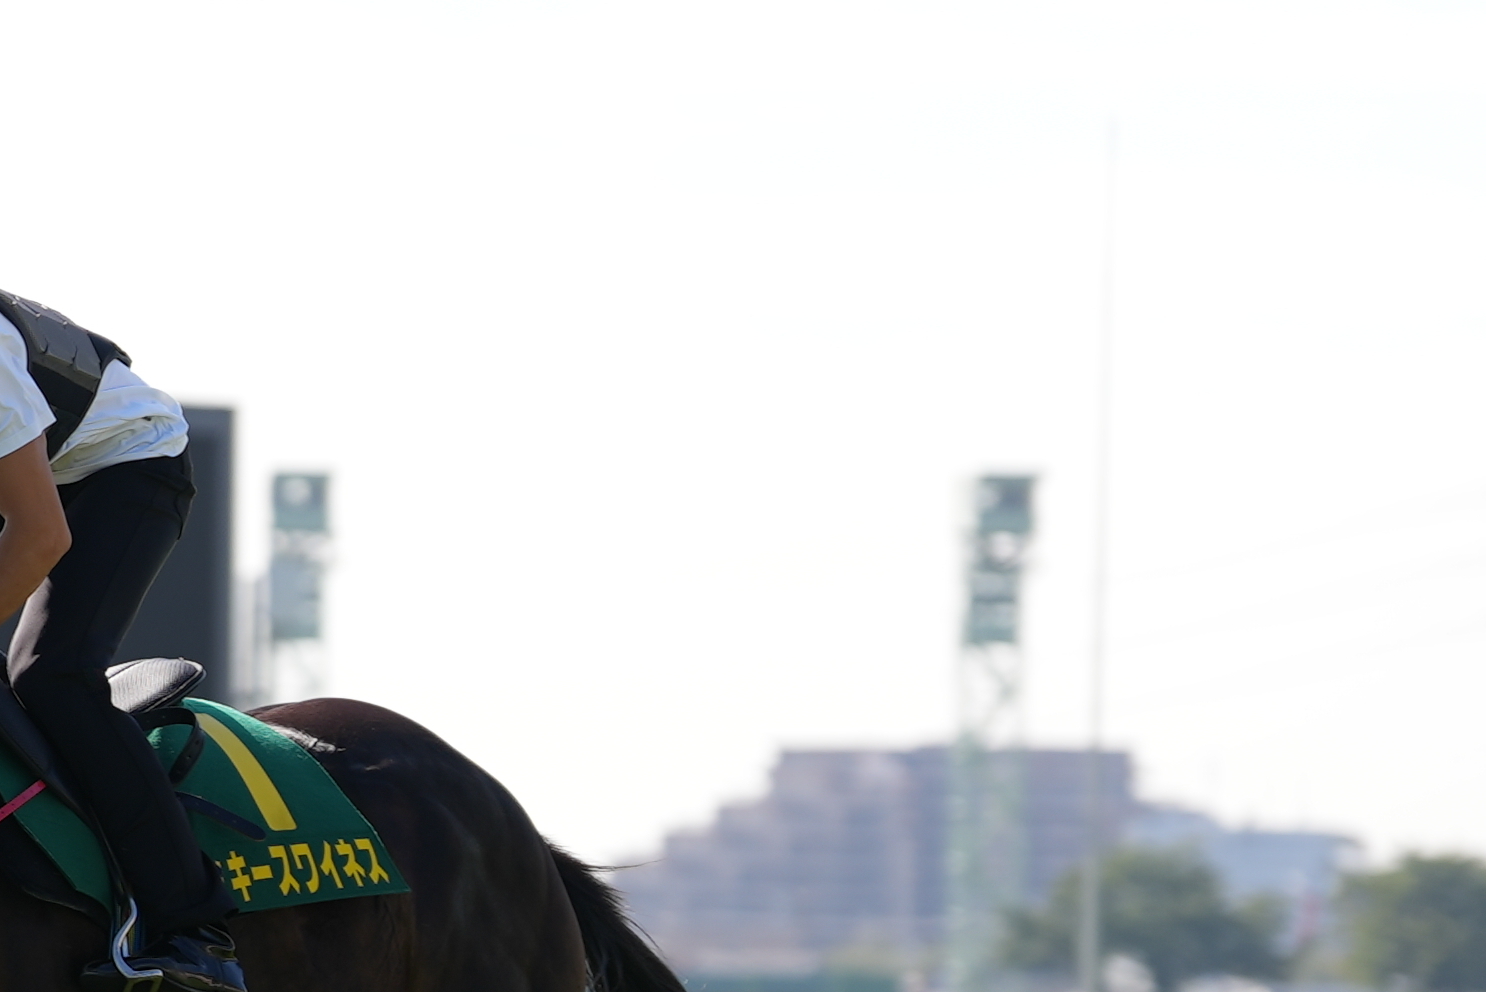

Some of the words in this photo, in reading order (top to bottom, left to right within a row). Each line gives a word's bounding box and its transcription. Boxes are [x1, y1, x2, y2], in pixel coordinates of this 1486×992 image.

[215, 838, 390, 902] キースワイネス
